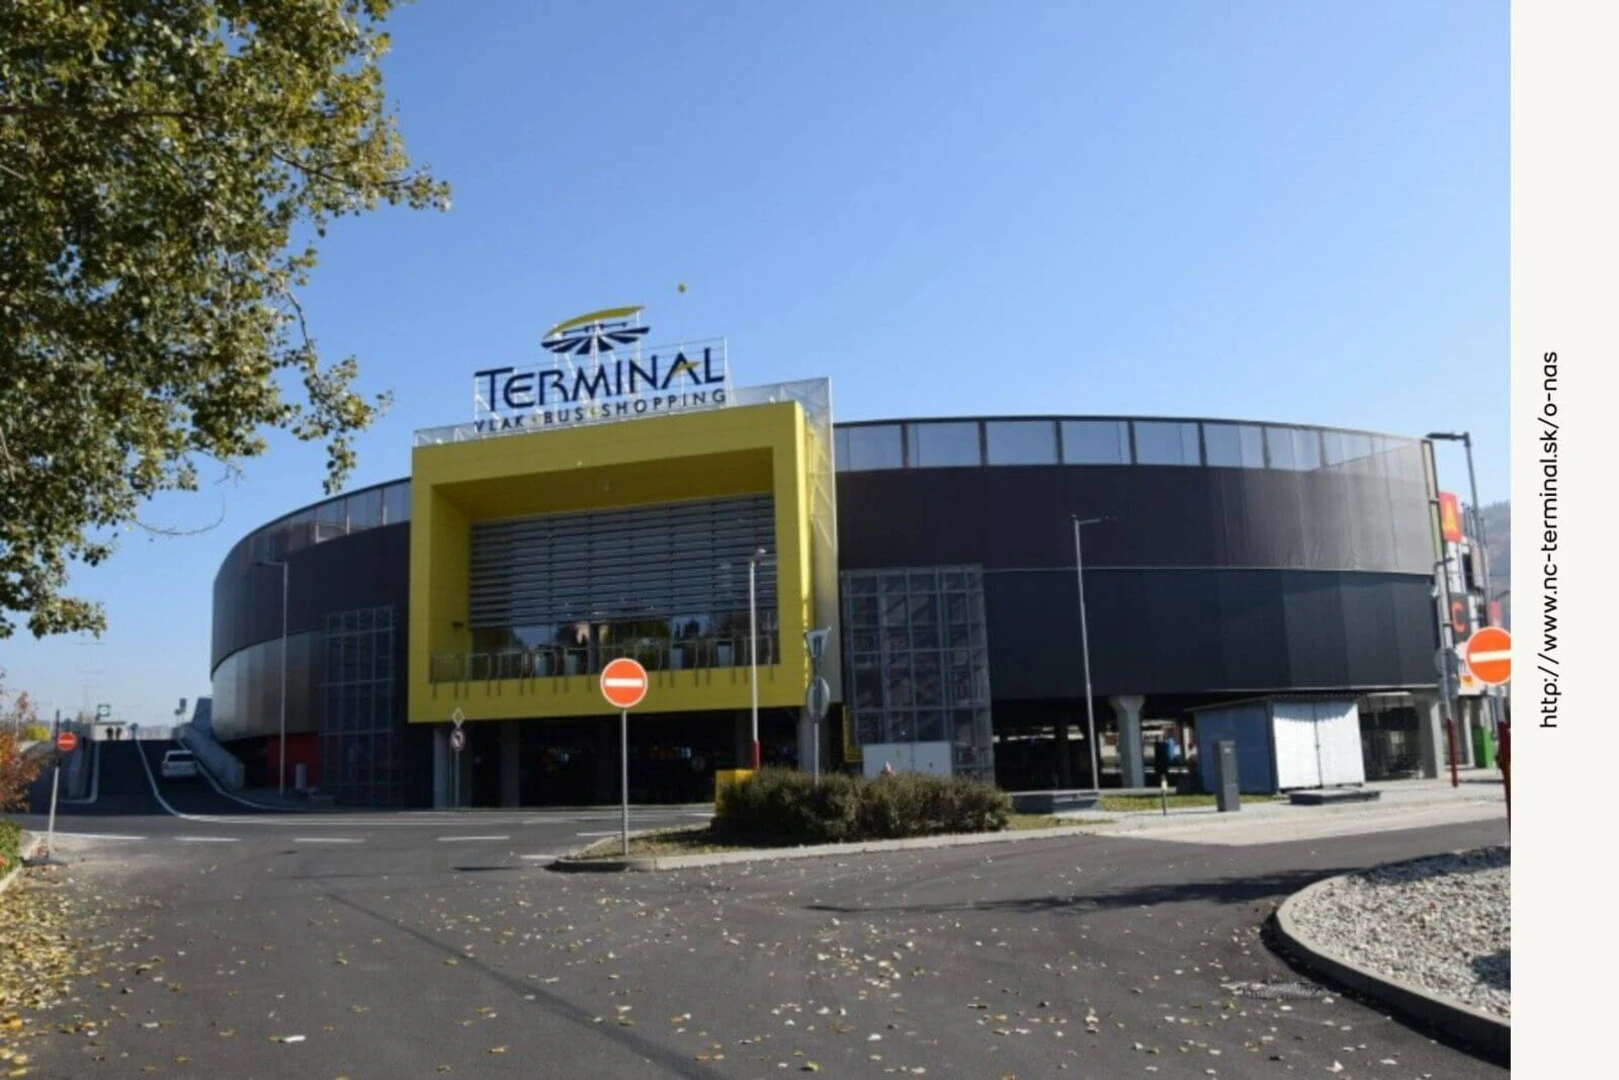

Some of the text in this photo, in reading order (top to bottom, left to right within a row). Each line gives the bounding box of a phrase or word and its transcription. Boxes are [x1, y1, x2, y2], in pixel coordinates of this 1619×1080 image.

[474, 347, 725, 412] TERMINAL
[474, 388, 726, 433] VLAK BUS SHOPPING
